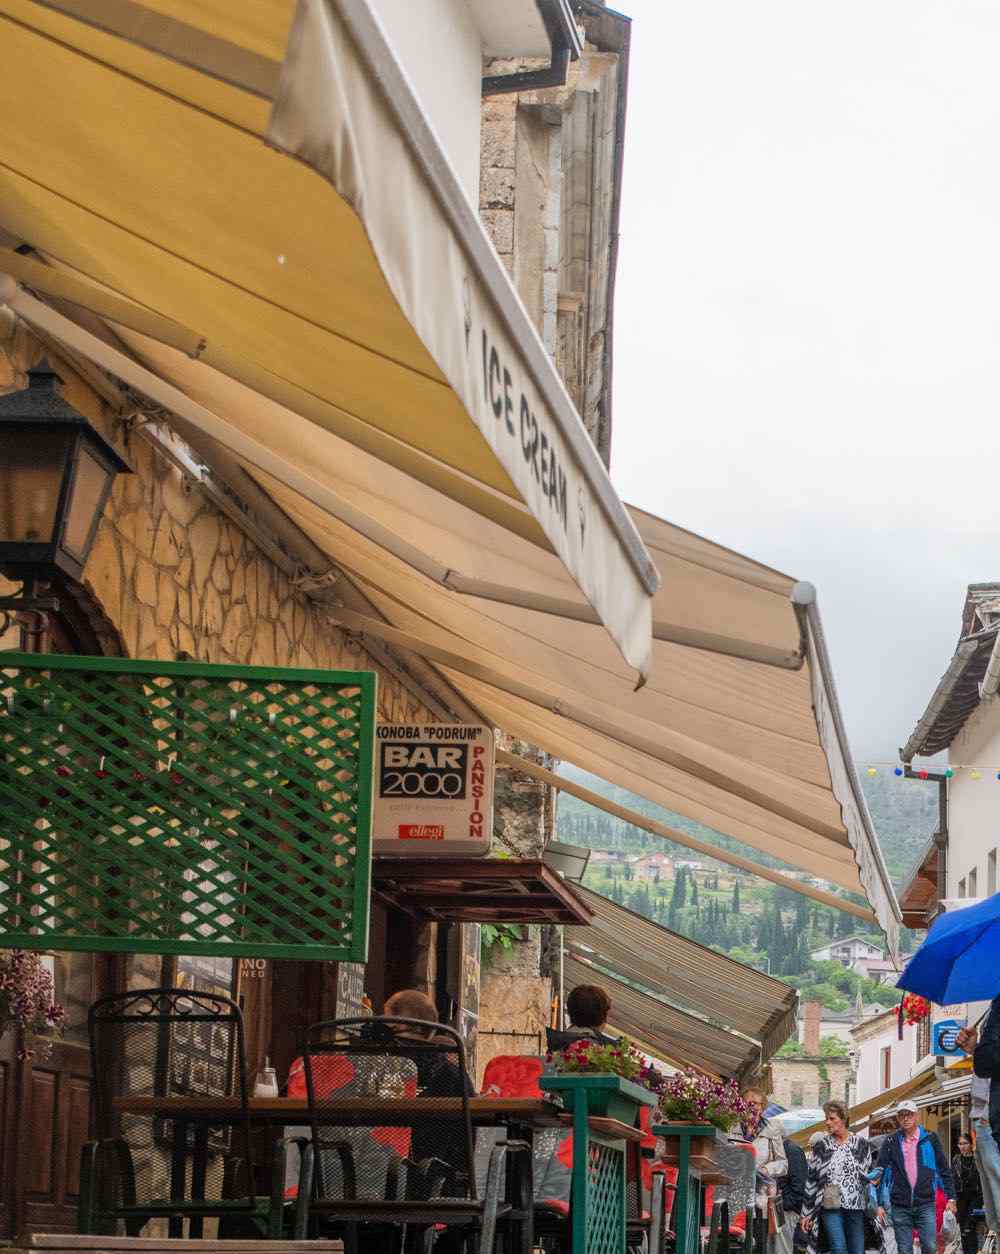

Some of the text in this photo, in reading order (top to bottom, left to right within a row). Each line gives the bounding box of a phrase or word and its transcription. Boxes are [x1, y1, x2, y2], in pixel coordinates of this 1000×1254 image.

[482, 328, 568, 534] ICE CREAM
[424, 727, 482, 740] "PODRUM"
[384, 746, 463, 769] BAR
[383, 772, 462, 796] 2000
[469, 746, 485, 838] PANSION
